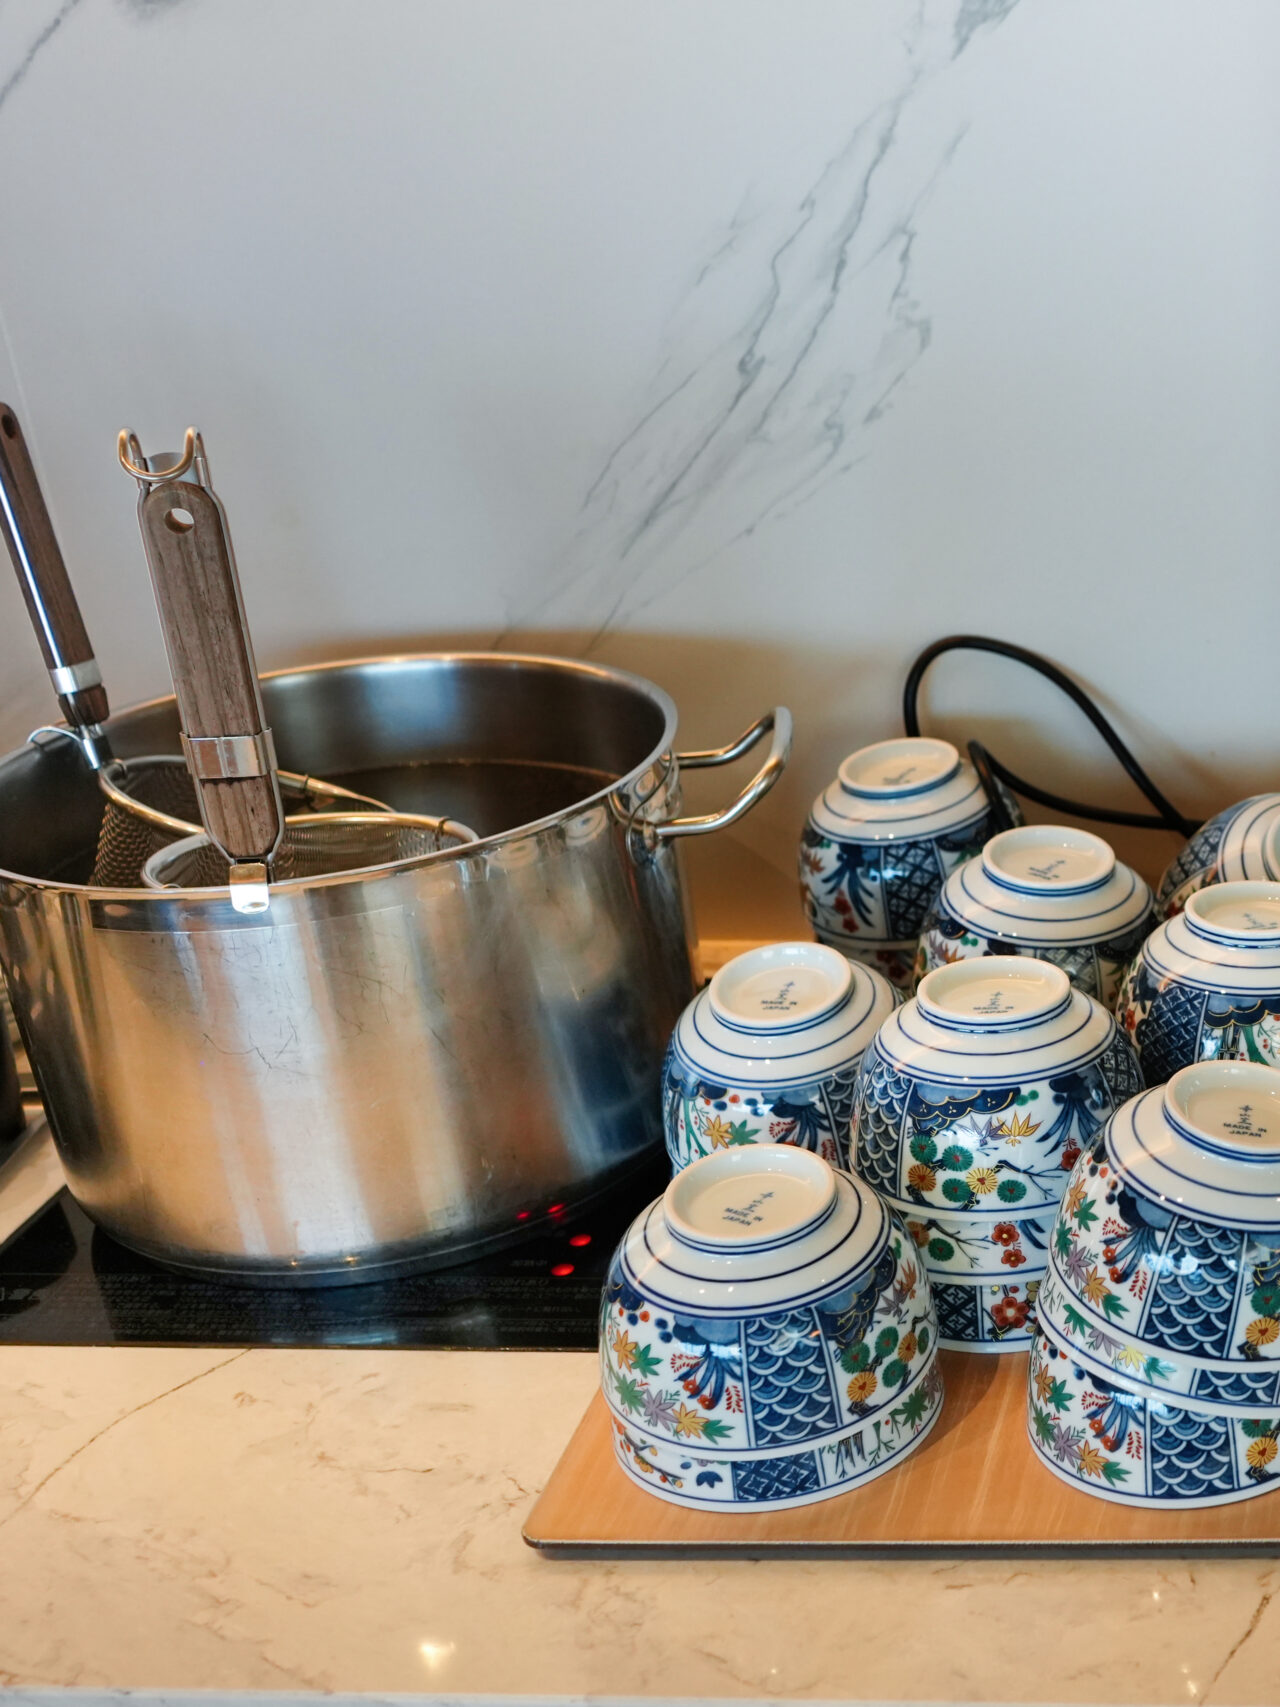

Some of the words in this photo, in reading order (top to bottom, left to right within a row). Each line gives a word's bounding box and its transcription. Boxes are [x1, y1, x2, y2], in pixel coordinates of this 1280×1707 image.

[1223, 1121, 1252, 1131] MADE
[1228, 1129, 1262, 1138] JAPAN
[724, 1206, 750, 1218] MADE
[752, 1214, 764, 1222] IN
[721, 1214, 752, 1226] JAPAN
